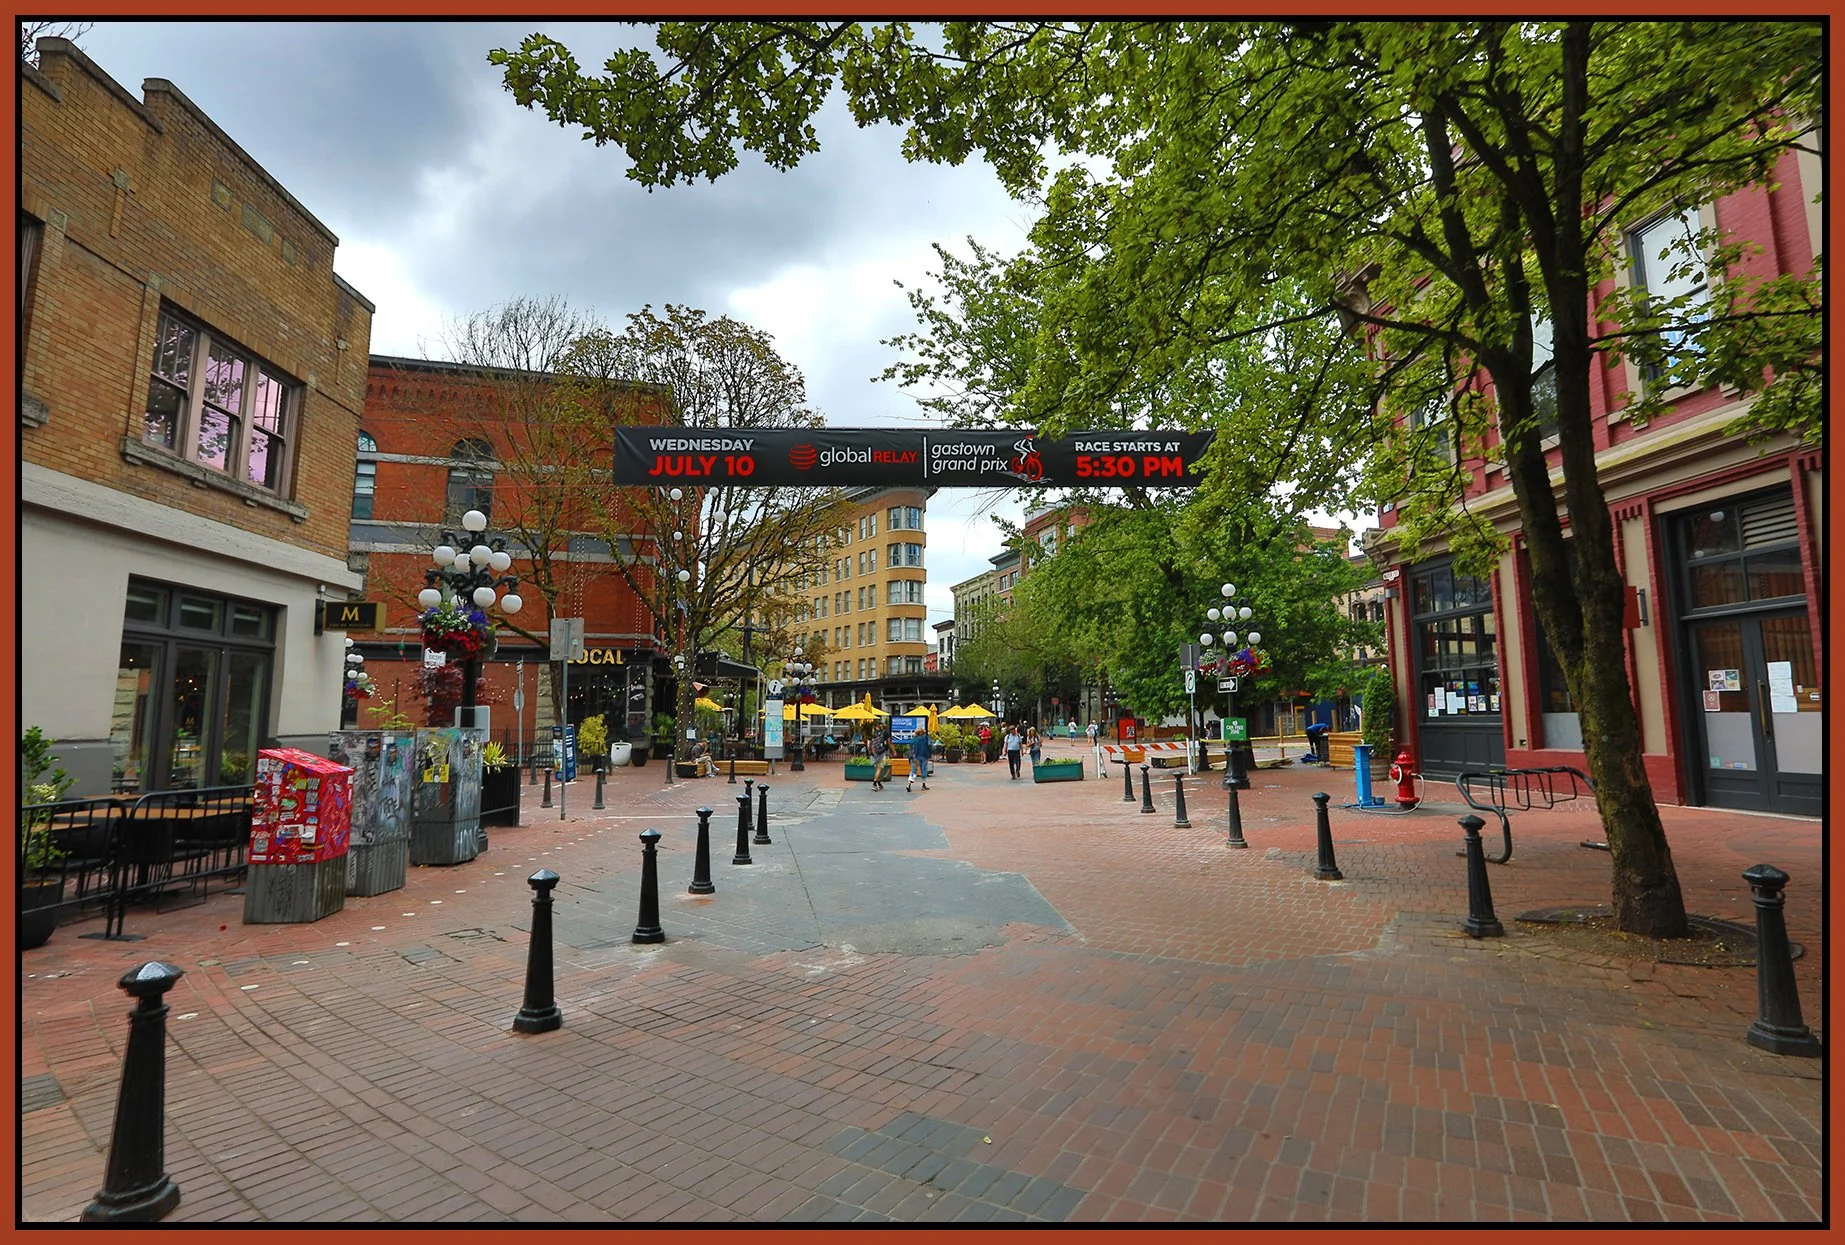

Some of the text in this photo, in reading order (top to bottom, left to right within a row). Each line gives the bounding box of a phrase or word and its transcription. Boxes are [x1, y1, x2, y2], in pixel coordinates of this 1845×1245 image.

[649, 438, 754, 451] WEDNESDAY
[931, 442, 996, 458] gastown
[1074, 441, 1181, 452] RACE STARTS AT
[819, 446, 872, 467] global
[932, 456, 1008, 474] grand prix
[648, 455, 755, 477] JULY 10
[1076, 455, 1183, 478] 5:30 PM
[340, 606, 360, 621] M
[567, 648, 624, 665] OCAL
